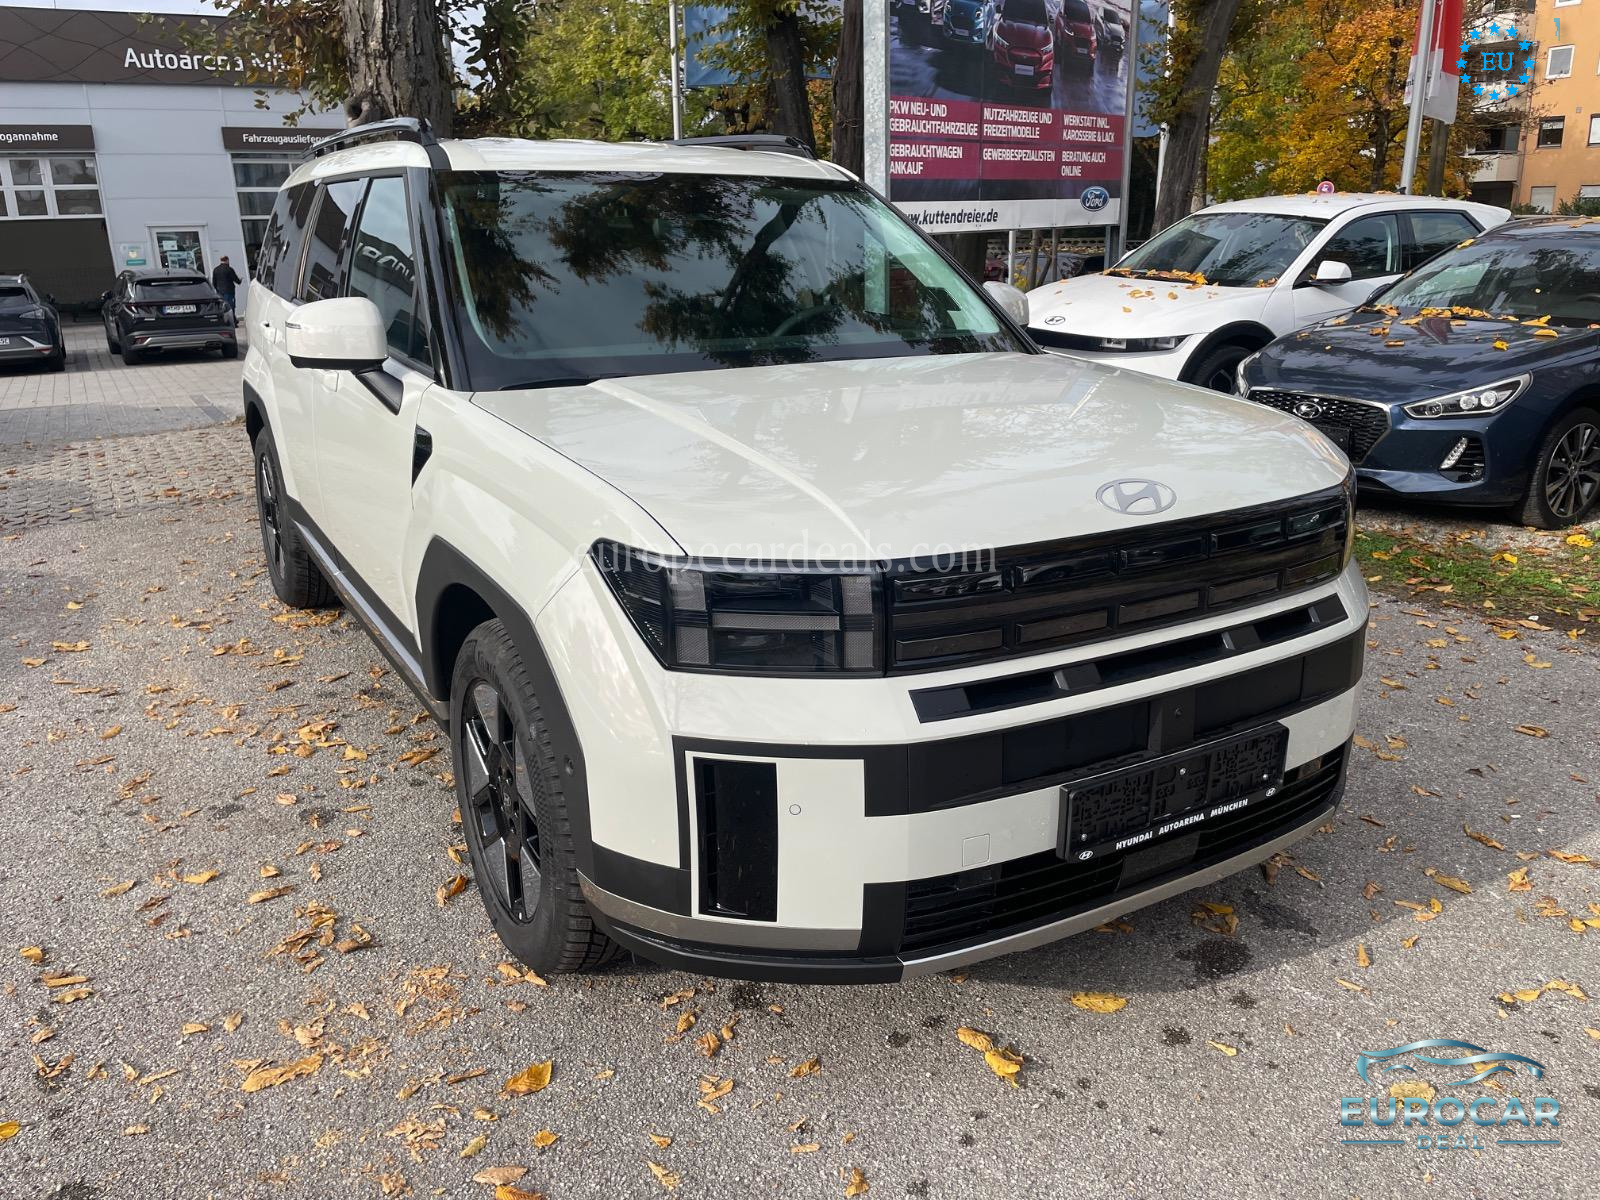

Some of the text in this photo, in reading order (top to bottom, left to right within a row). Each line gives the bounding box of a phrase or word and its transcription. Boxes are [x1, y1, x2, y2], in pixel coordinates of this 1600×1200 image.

[889, 100, 947, 117] PKW NEU- UND
[983, 107, 1053, 124] NUTZFAHRZEUGE UND
[889, 117, 978, 136] GEBRAUCHTFAHRZEUGE
[1063, 114, 1097, 127] WERKSTATT
[983, 123, 1040, 139] FREIZEITMODELLE
[1062, 129, 1097, 142] KAROSSERIE
[1102, 131, 1115, 143] LACK
[889, 143, 963, 159] GEBRAUCHTWAGEN
[982, 148, 1056, 162] GEWERBESPEZIALISTEN
[1061, 150, 1106, 163] BERATUNG AUCH
[889, 161, 923, 175] ANKAUF
[1061, 165, 1082, 177] ONLINE
[1085, 190, 1105, 207] Ford
[1115, 798, 1248, 850] HYUNDAI AUTOARENA MÜNCHEN
